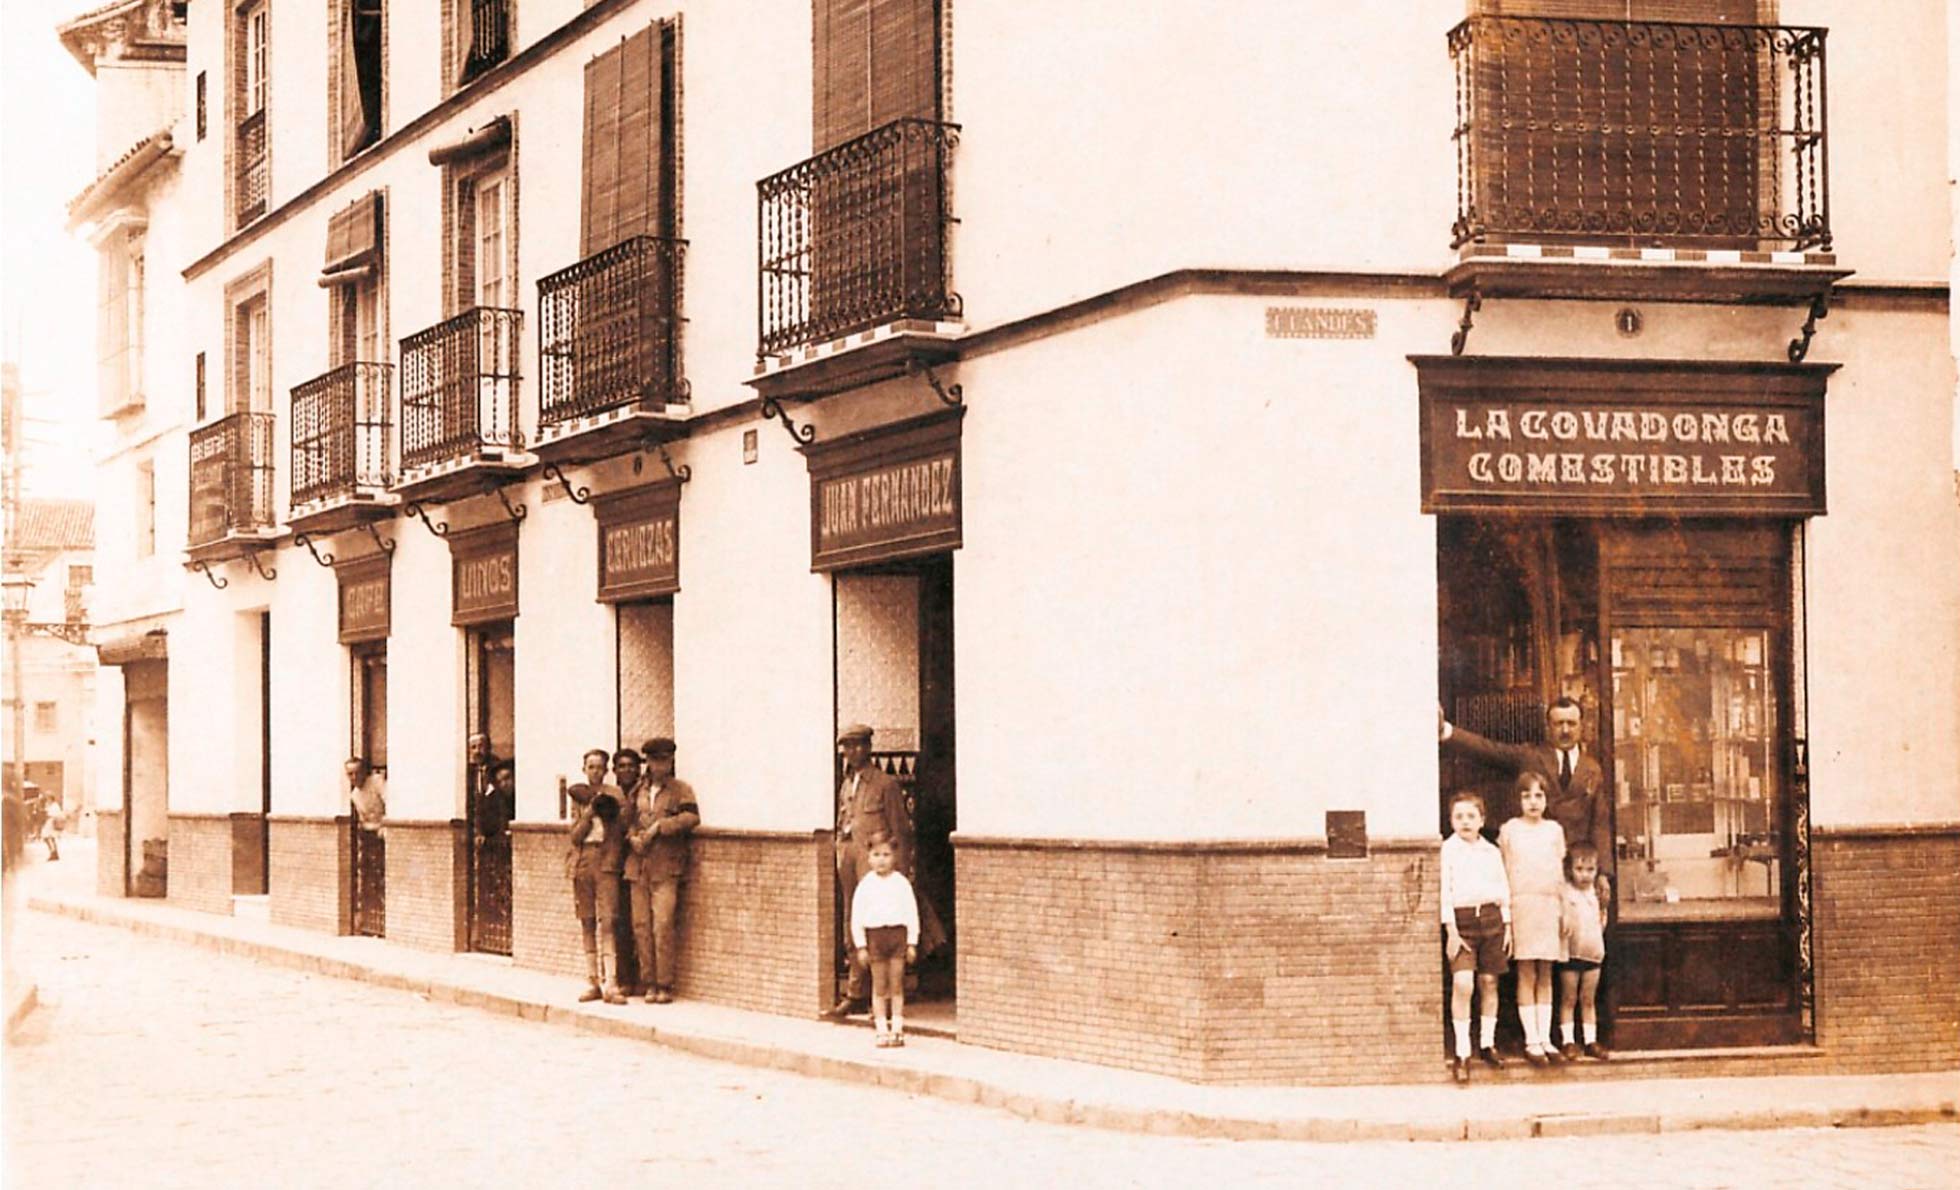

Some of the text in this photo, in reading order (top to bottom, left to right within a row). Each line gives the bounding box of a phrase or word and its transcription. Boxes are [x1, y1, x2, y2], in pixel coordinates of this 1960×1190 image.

[1455, 408, 1790, 444] LA COVADONGA
[1467, 452, 1777, 486] COMESTIBLES
[821, 458, 953, 536] JUAN FERNANDEZ
[607, 520, 673, 573] CERVEZAS
[461, 554, 511, 599] VINOS
